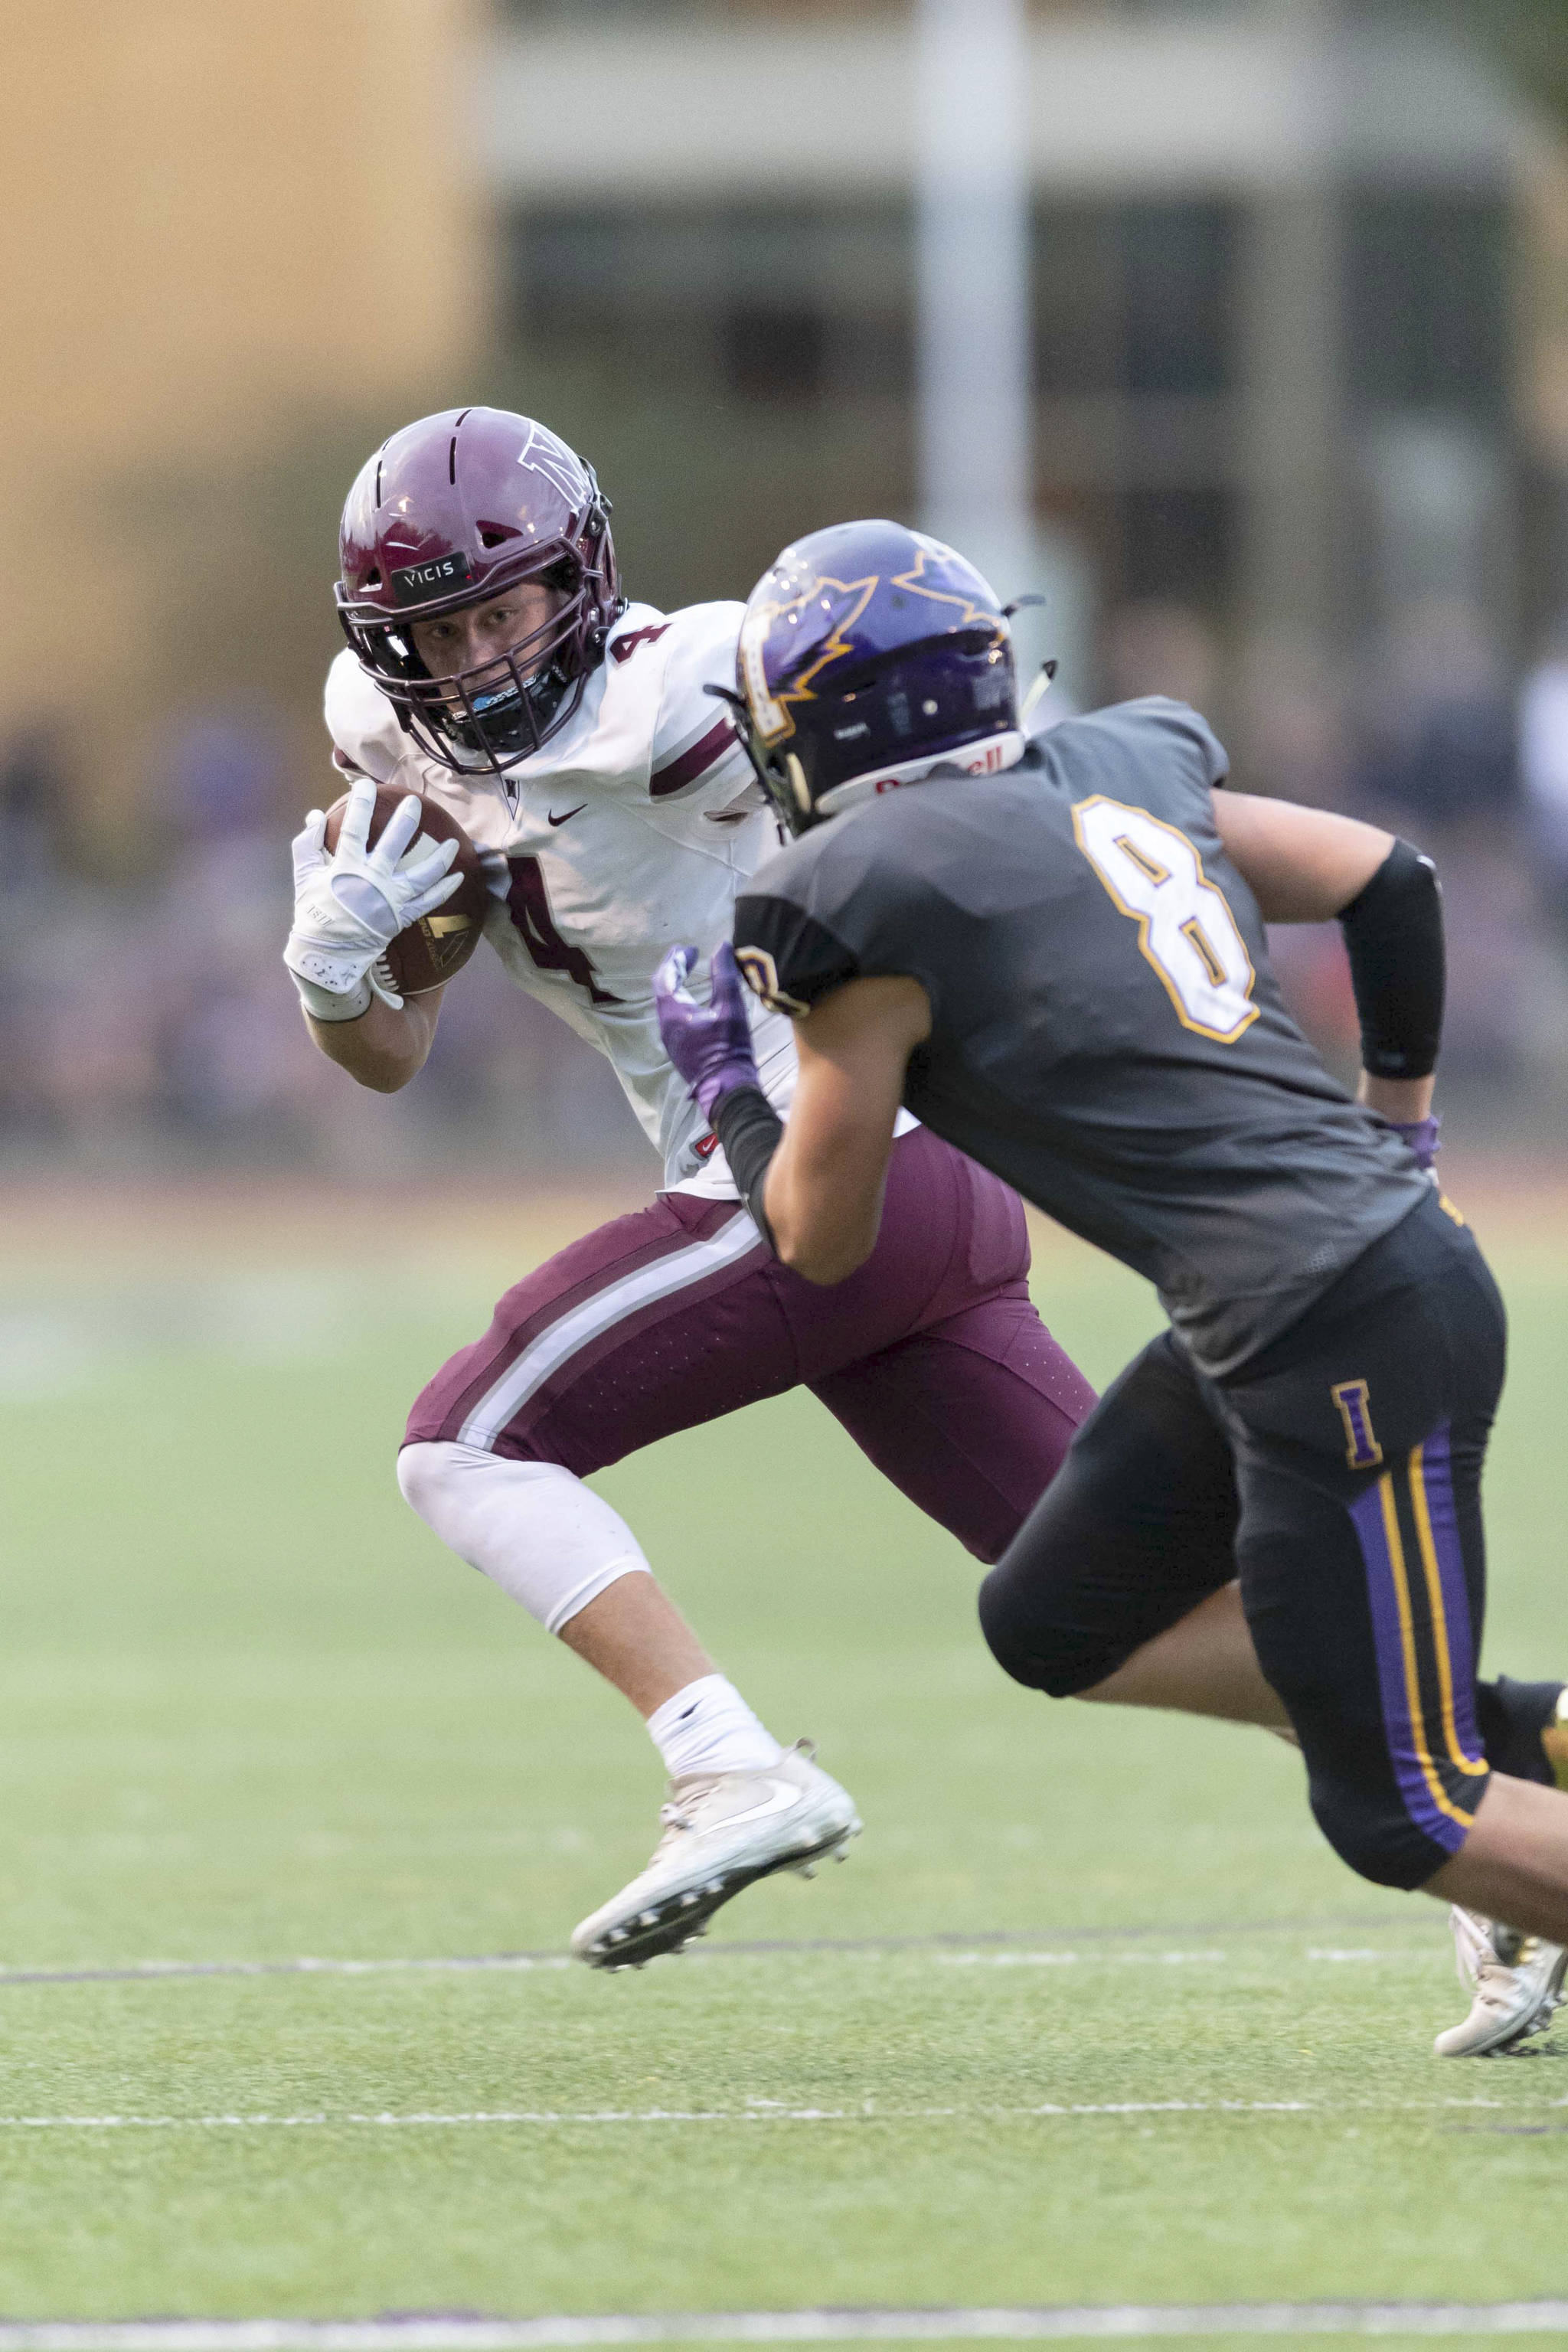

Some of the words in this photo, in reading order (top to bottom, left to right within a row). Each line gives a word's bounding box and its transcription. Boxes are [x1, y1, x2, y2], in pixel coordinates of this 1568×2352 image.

[404, 561, 454, 587] VICIS
[608, 622, 675, 666] 4
[505, 854, 628, 1004] 4
[1070, 794, 1261, 1044] 8
[1331, 1378, 1383, 1470] I
